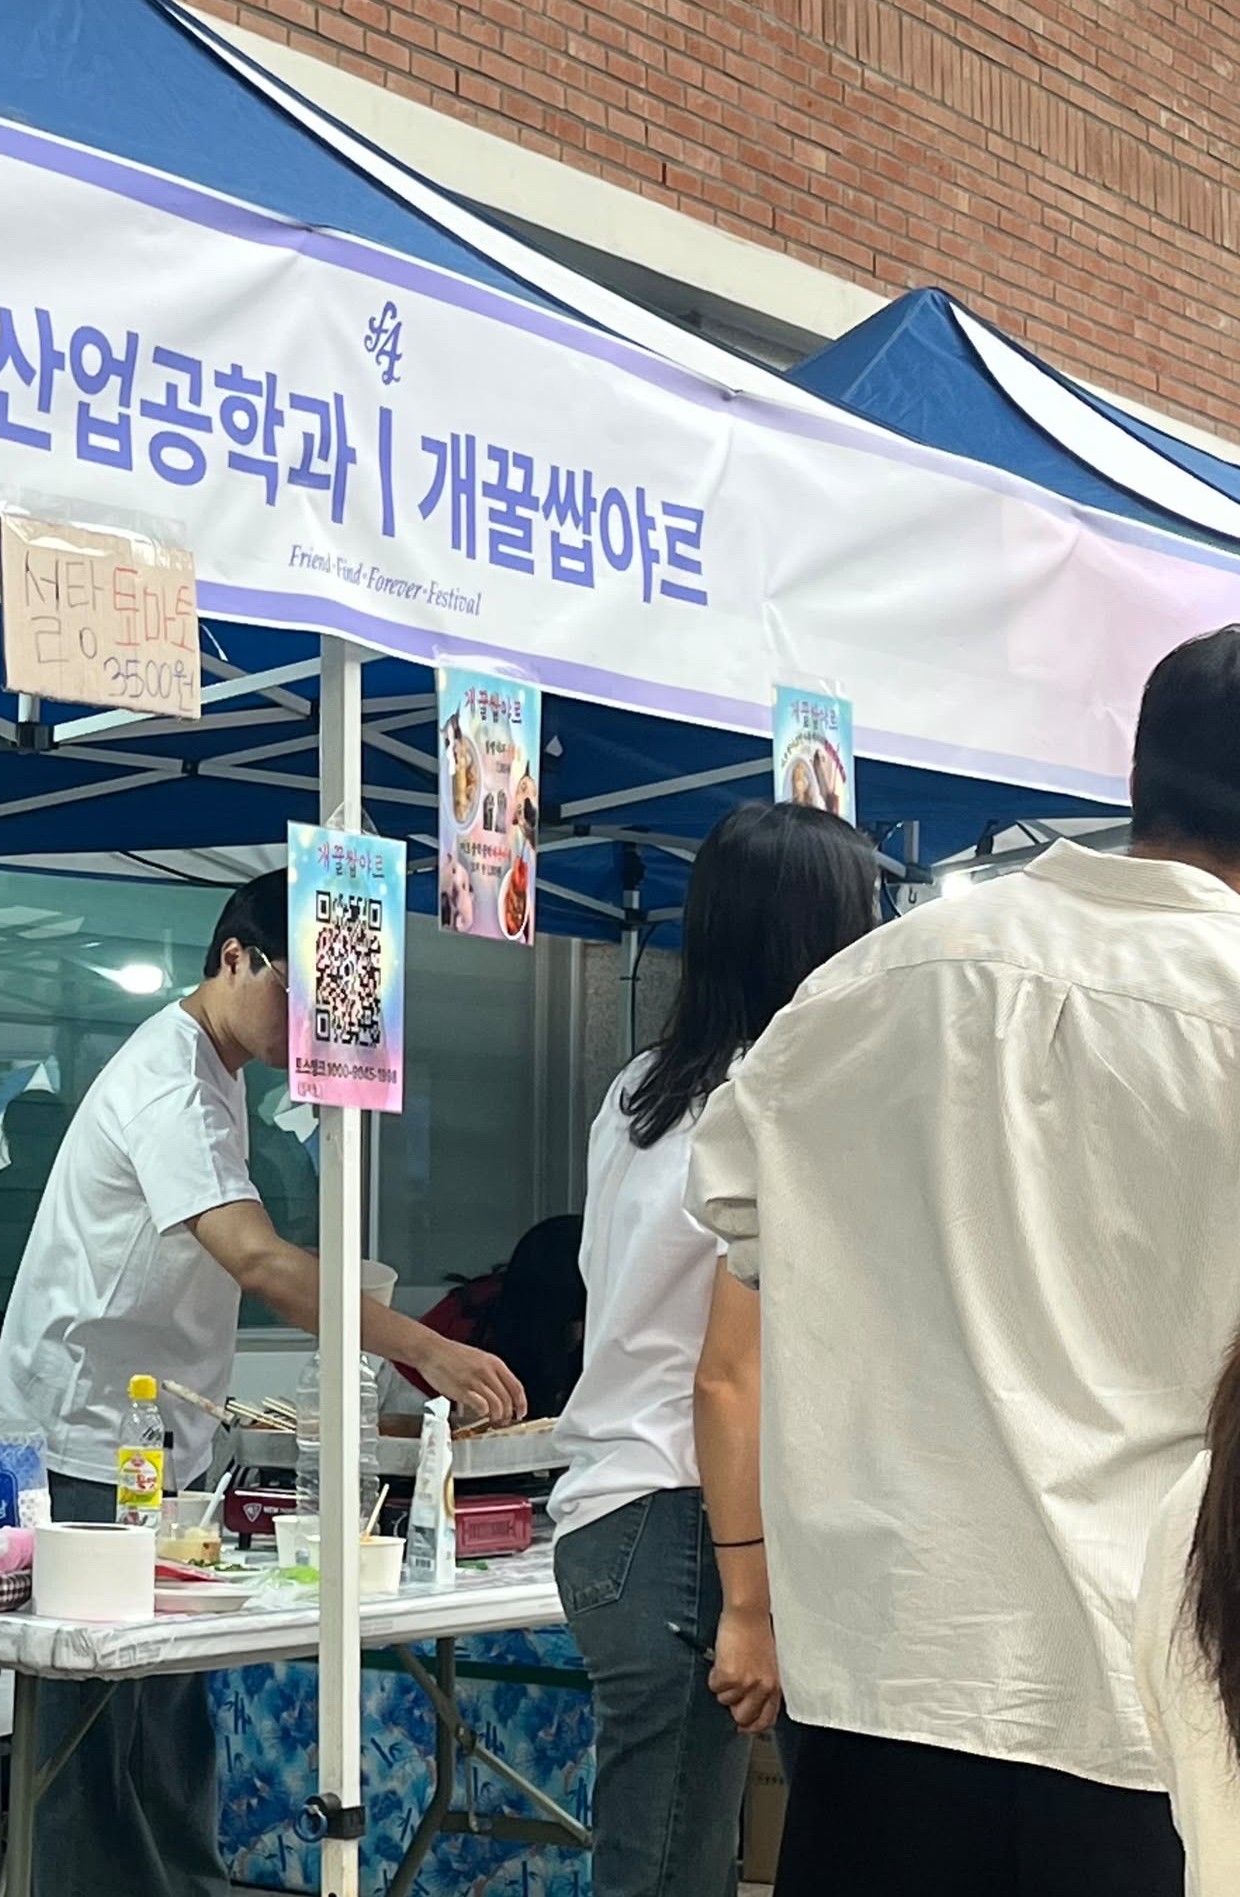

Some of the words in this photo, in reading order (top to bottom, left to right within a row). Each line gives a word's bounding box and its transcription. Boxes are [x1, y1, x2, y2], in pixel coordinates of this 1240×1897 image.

[417, 431, 708, 607] 개꿀쌉야르
[25, 550, 196, 664] 설탕토마토
[104, 657, 195, 712] 3500원
